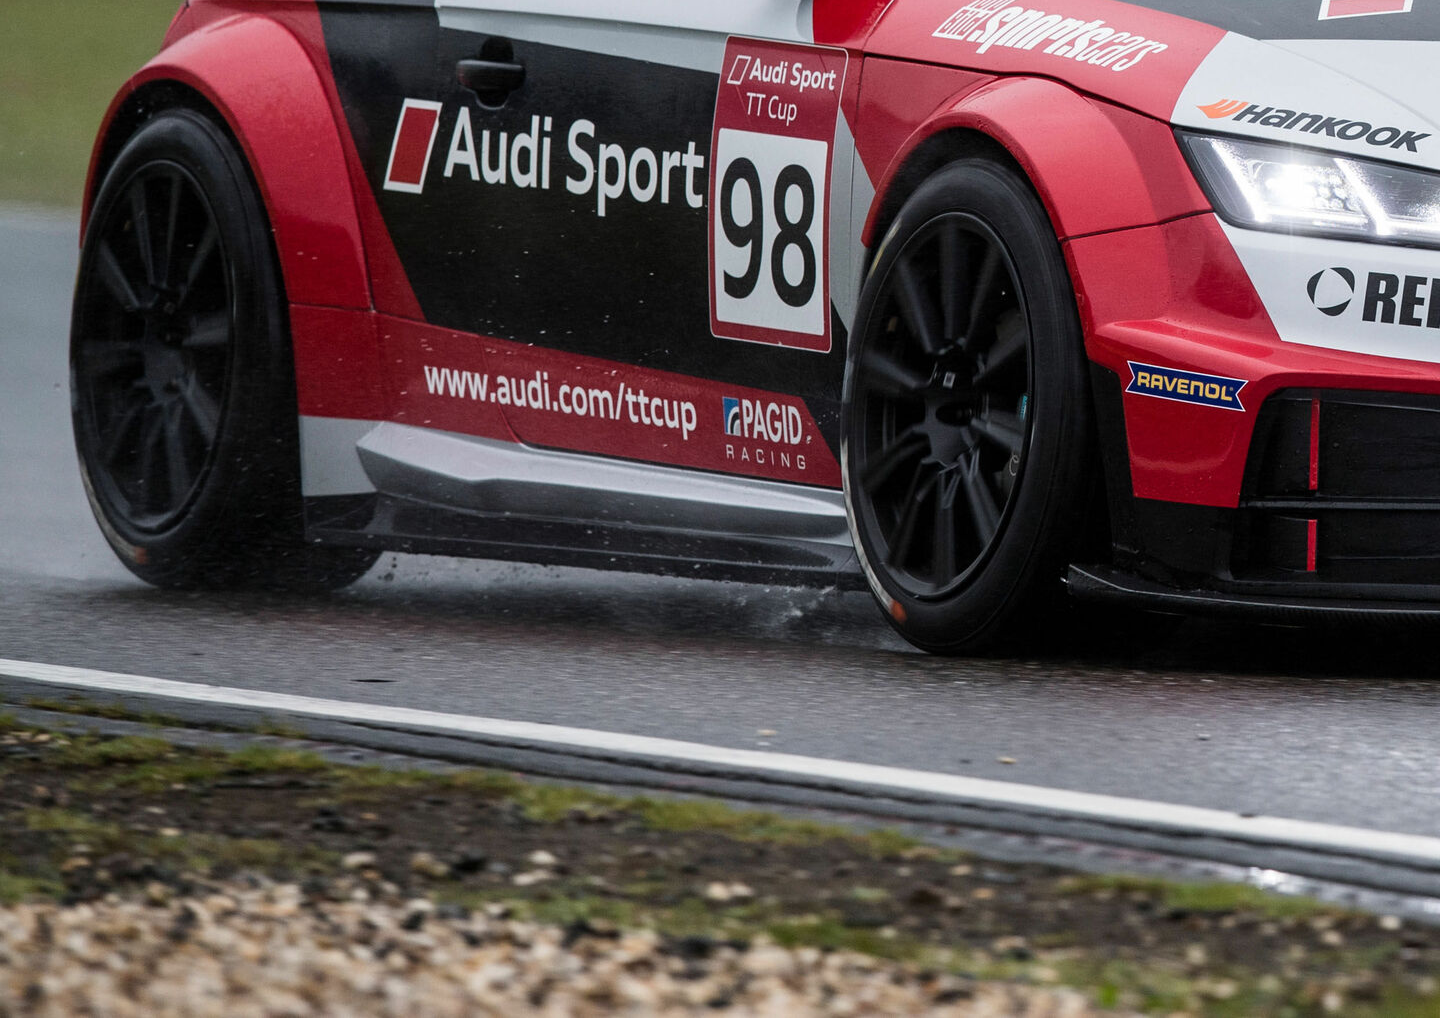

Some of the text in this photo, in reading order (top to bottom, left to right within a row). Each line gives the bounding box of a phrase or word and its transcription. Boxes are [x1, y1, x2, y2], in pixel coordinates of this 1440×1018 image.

[749, 58, 836, 92] Audi Sport
[746, 92, 798, 126] TT Cup
[444, 107, 705, 217] Audi Sport
[719, 157, 818, 307] 98
[423, 365, 698, 442] www.audi.com/ttcup
[741, 398, 803, 445] PAGID
[725, 444, 806, 470] RACING
